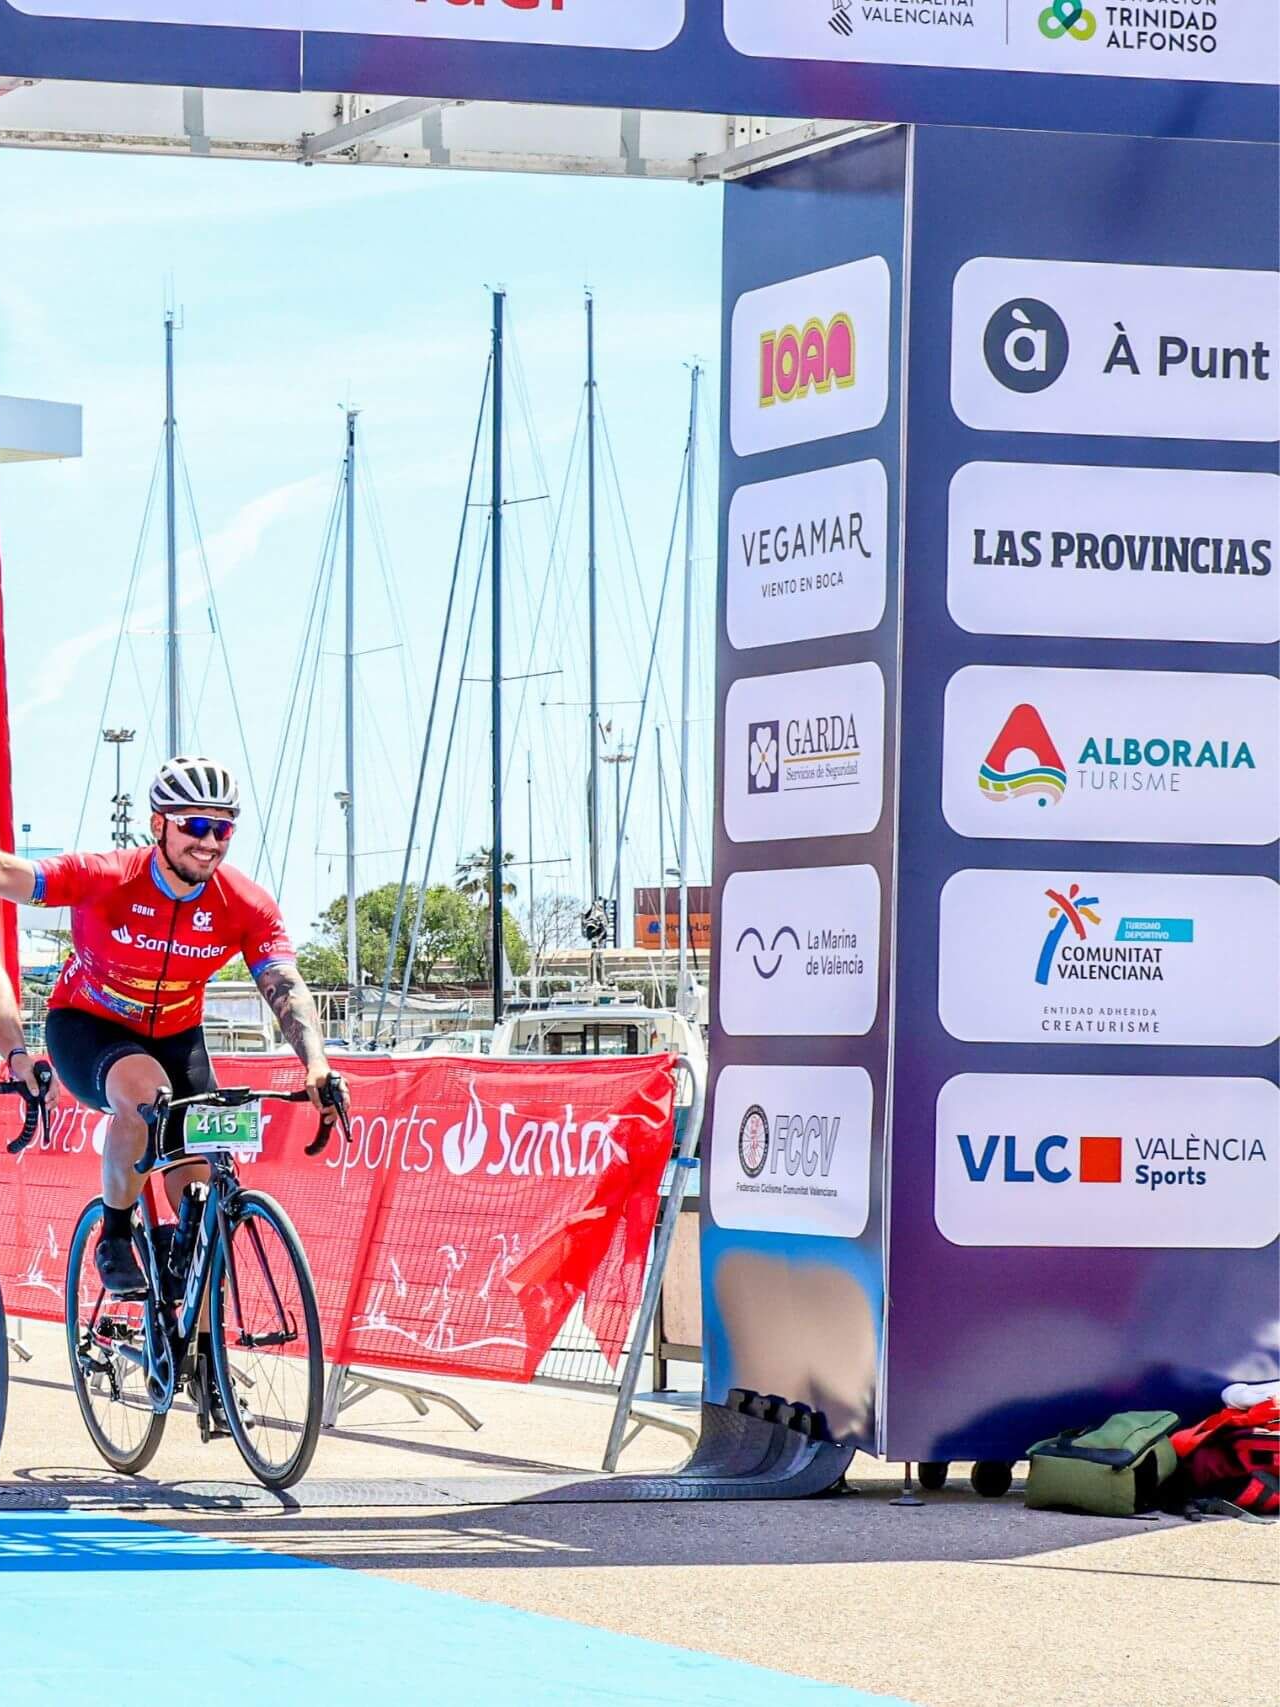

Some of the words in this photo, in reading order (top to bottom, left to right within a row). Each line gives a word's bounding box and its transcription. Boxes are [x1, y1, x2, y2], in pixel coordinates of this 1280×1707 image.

[862, 6, 974, 27] VALENCIANA
[1106, 7, 1217, 30] TRINIDAD
[1106, 30, 1217, 53] ALFONSO
[1103, 321, 1140, 375] À
[1159, 336, 1270, 381] Punt
[742, 512, 872, 568] VEGAMAR
[973, 529, 1042, 568] LAS
[1051, 531, 1271, 576] PROVINCIAS
[761, 578, 797, 598] VIENTO
[800, 576, 813, 592] EN
[816, 571, 844, 590] BOCA
[786, 712, 859, 756] GARDA
[1078, 737, 1256, 769] ALBORAIA
[1077, 770, 1181, 792] TURISME
[1125, 921, 1161, 930] TURISMO
[1125, 931, 1169, 940] DEPORTIVO
[134, 934, 227, 958] Santander
[808, 930, 819, 950] La
[821, 928, 857, 949] Marina
[806, 955, 819, 975] de
[821, 954, 863, 975] València
[1062, 946, 1163, 963] COMUNITAT
[1058, 964, 1164, 981] VALENCIANA
[1044, 1006, 1093, 1016] ENTIDAD
[1099, 1007, 1157, 1017] ADHERIDA
[1042, 1020, 1160, 1033] CREATURISME
[196, 1114, 238, 1134] 415
[770, 1114, 841, 1177] FCCV
[956, 1135, 1072, 1183] VLC
[1135, 1134, 1266, 1162] VALÈNCIA
[1135, 1164, 1206, 1190] Sports
